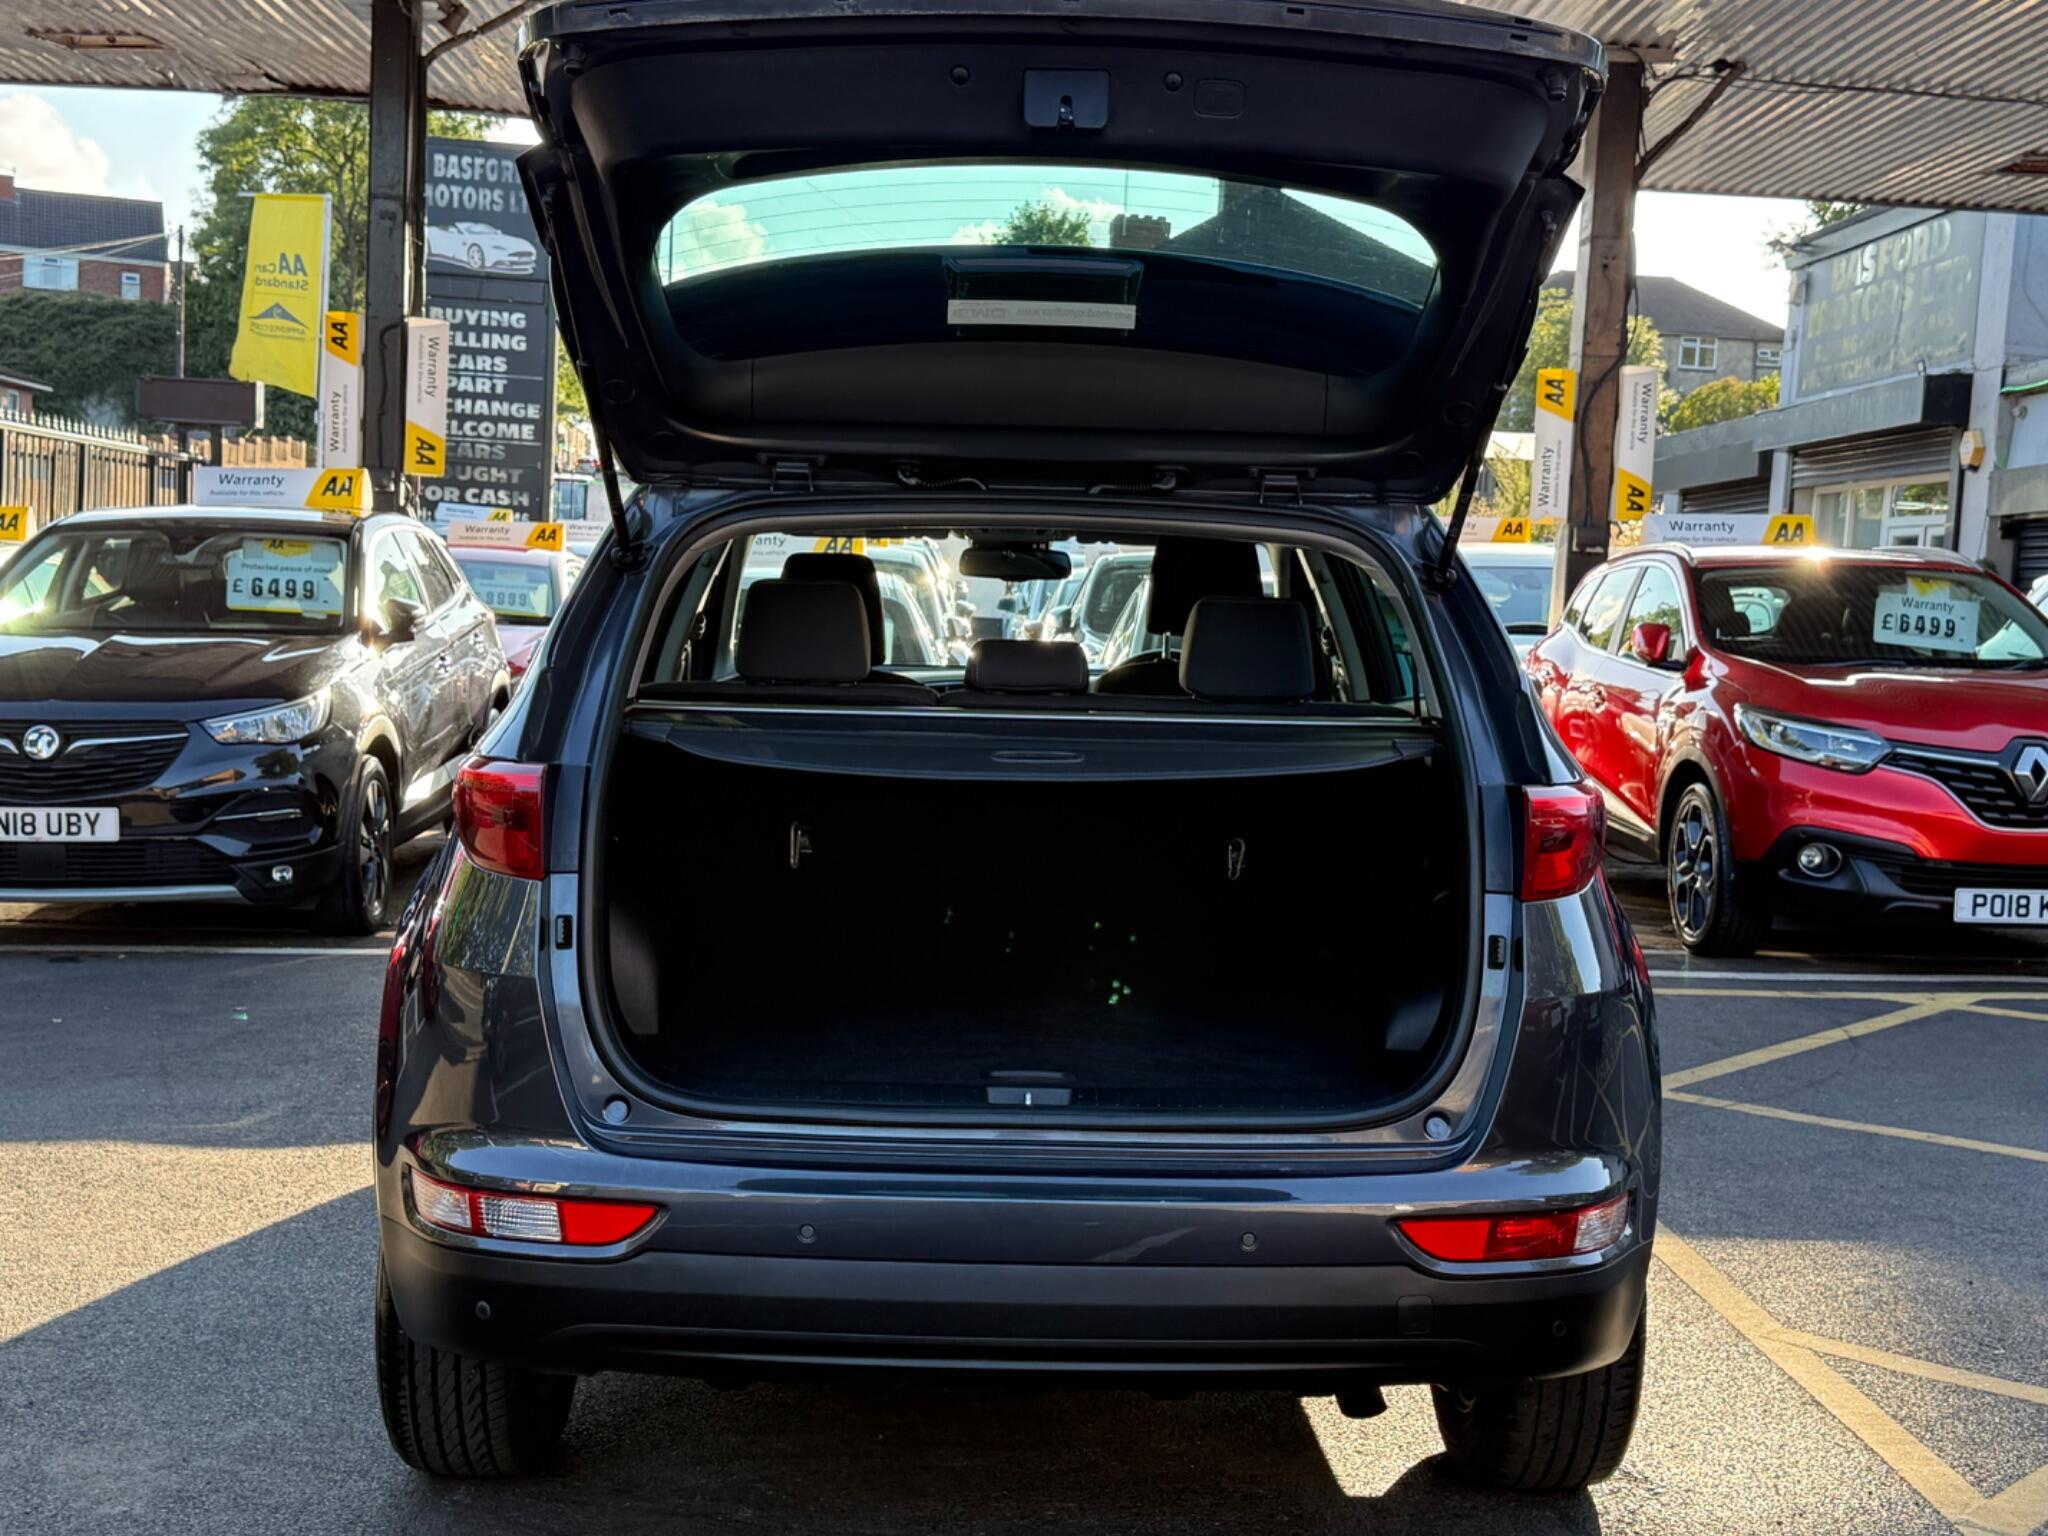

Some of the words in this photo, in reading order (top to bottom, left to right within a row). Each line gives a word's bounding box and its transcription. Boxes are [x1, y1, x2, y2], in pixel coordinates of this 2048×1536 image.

[433, 153, 521, 184] BASFOR
[331, 321, 348, 350] AA
[449, 331, 528, 351] ELLING
[425, 336, 441, 398] Warranty
[1545, 378, 1565, 407] AA
[447, 398, 541, 419] CHANGE
[1637, 384, 1653, 445] Warranty
[330, 391, 342, 453] Warranty
[446, 420, 535, 440] LCOME
[415, 437, 436, 466] AA
[218, 473, 285, 488] Warranty
[322, 475, 354, 497] AA
[1537, 446, 1554, 507] Warranty
[465, 488, 530, 507] CASH
[1627, 483, 1645, 512] AA
[493, 511, 507, 521] AA
[465, 524, 511, 535] Warranty
[536, 528, 557, 542] AA
[1502, 522, 1524, 536] AA
[1669, 520, 1735, 534] Warranty
[1773, 522, 1804, 542] AA
[755, 536, 786, 547] anty
[232, 577, 315, 600] £6499
[1901, 597, 1955, 615] Warranty
[1881, 613, 1956, 638] £6499
[46, 812, 100, 836] UBY
[1972, 894, 2031, 918] PO18
